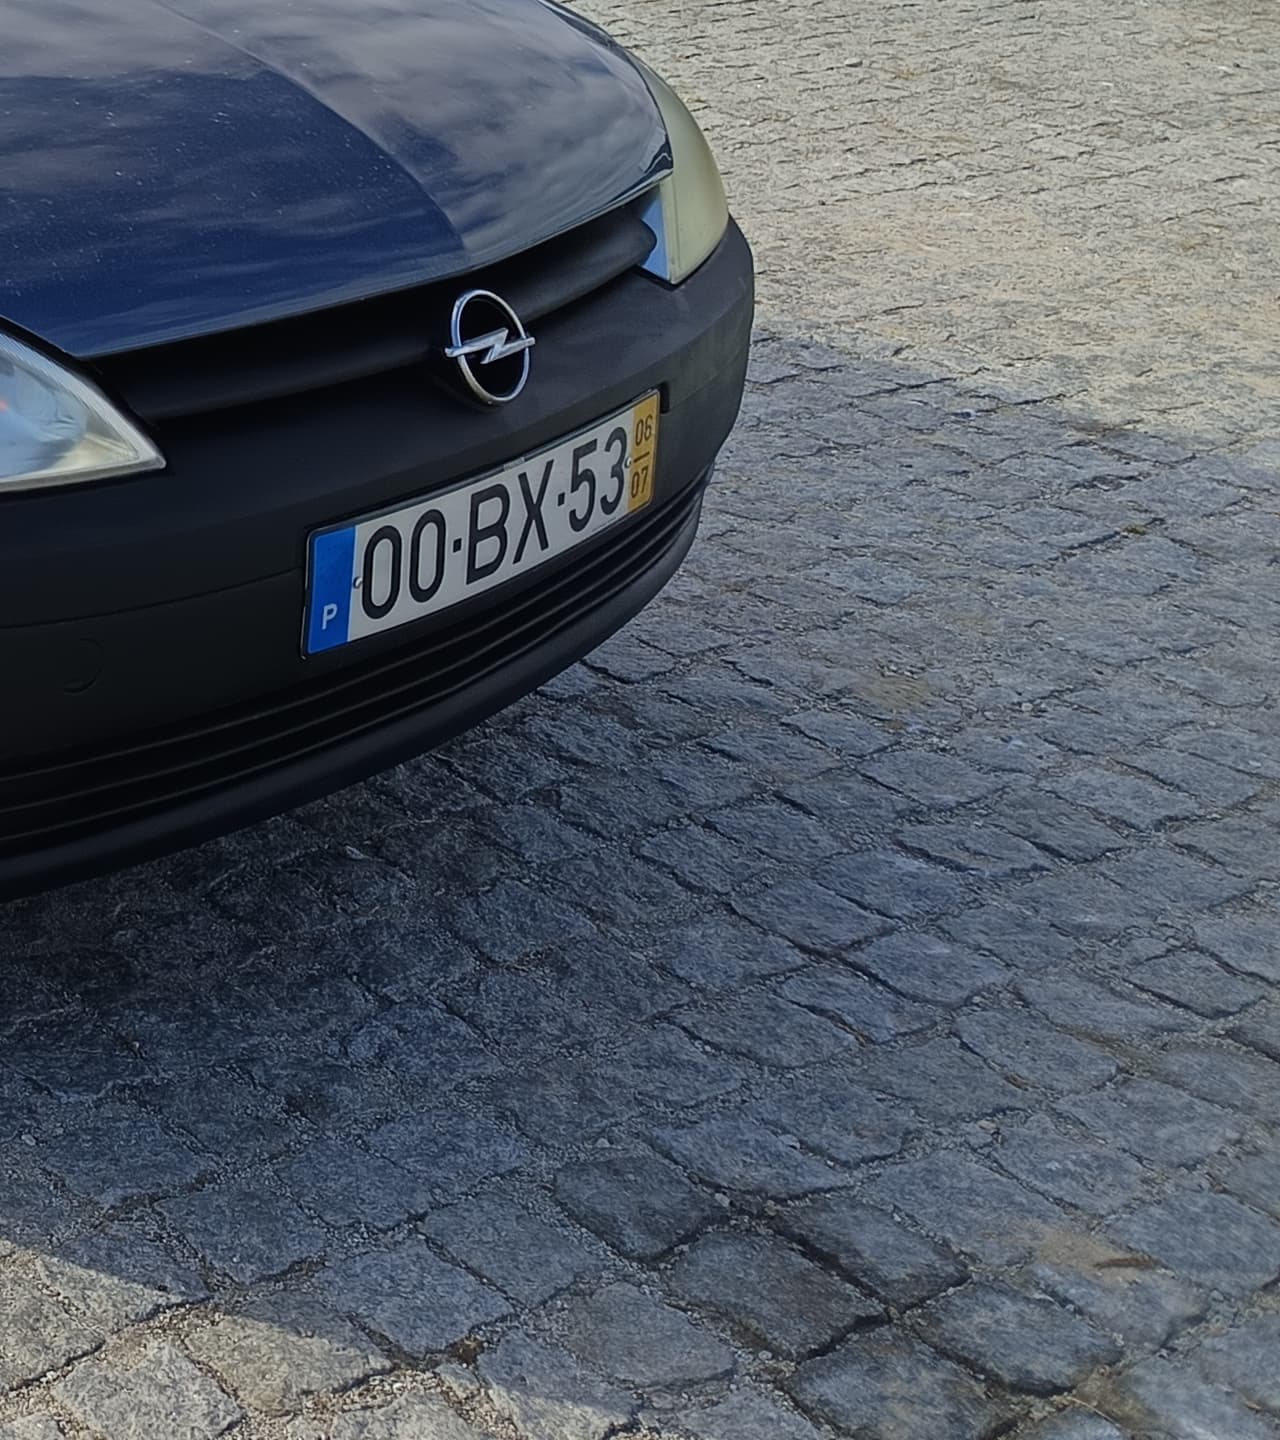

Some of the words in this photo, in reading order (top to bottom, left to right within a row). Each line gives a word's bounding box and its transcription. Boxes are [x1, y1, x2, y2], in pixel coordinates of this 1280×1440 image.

[634, 412, 654, 448] 06
[630, 465, 650, 500] 07
[320, 603, 338, 632] P
